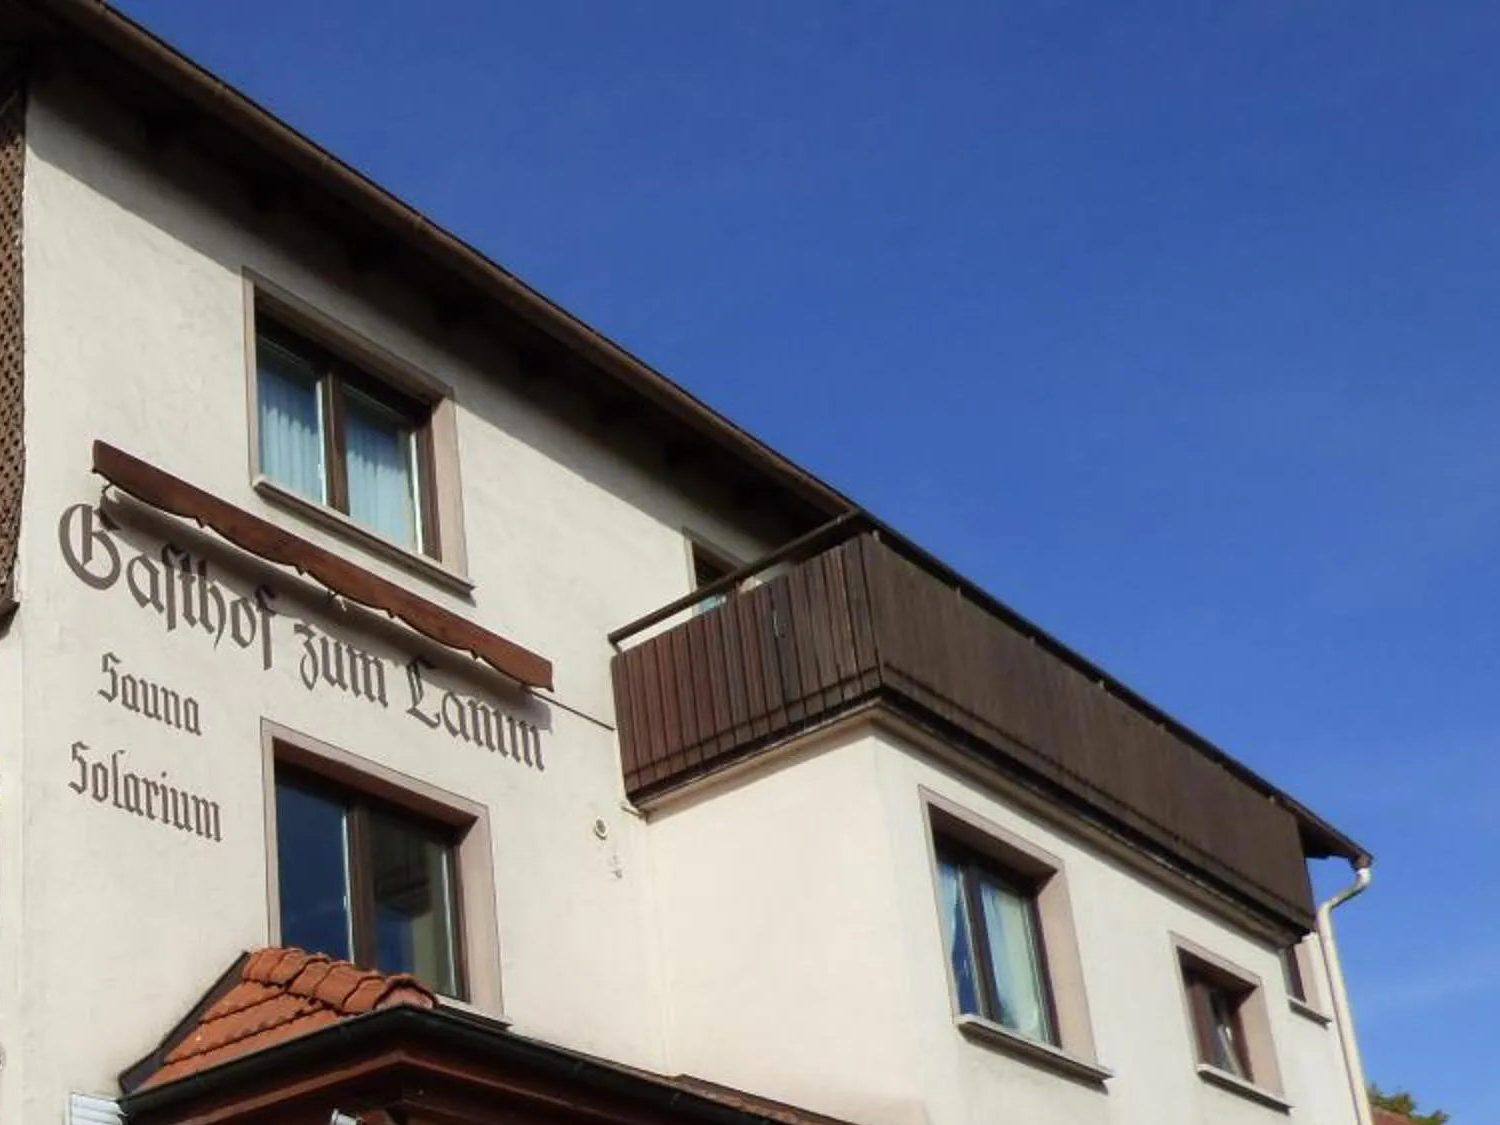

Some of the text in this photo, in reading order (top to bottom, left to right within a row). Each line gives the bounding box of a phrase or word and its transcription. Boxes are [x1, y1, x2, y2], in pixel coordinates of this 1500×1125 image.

[57, 502, 545, 772] Gasthof zum Lamm
[97, 651, 203, 737] Sauna
[67, 740, 222, 843] Solarium
